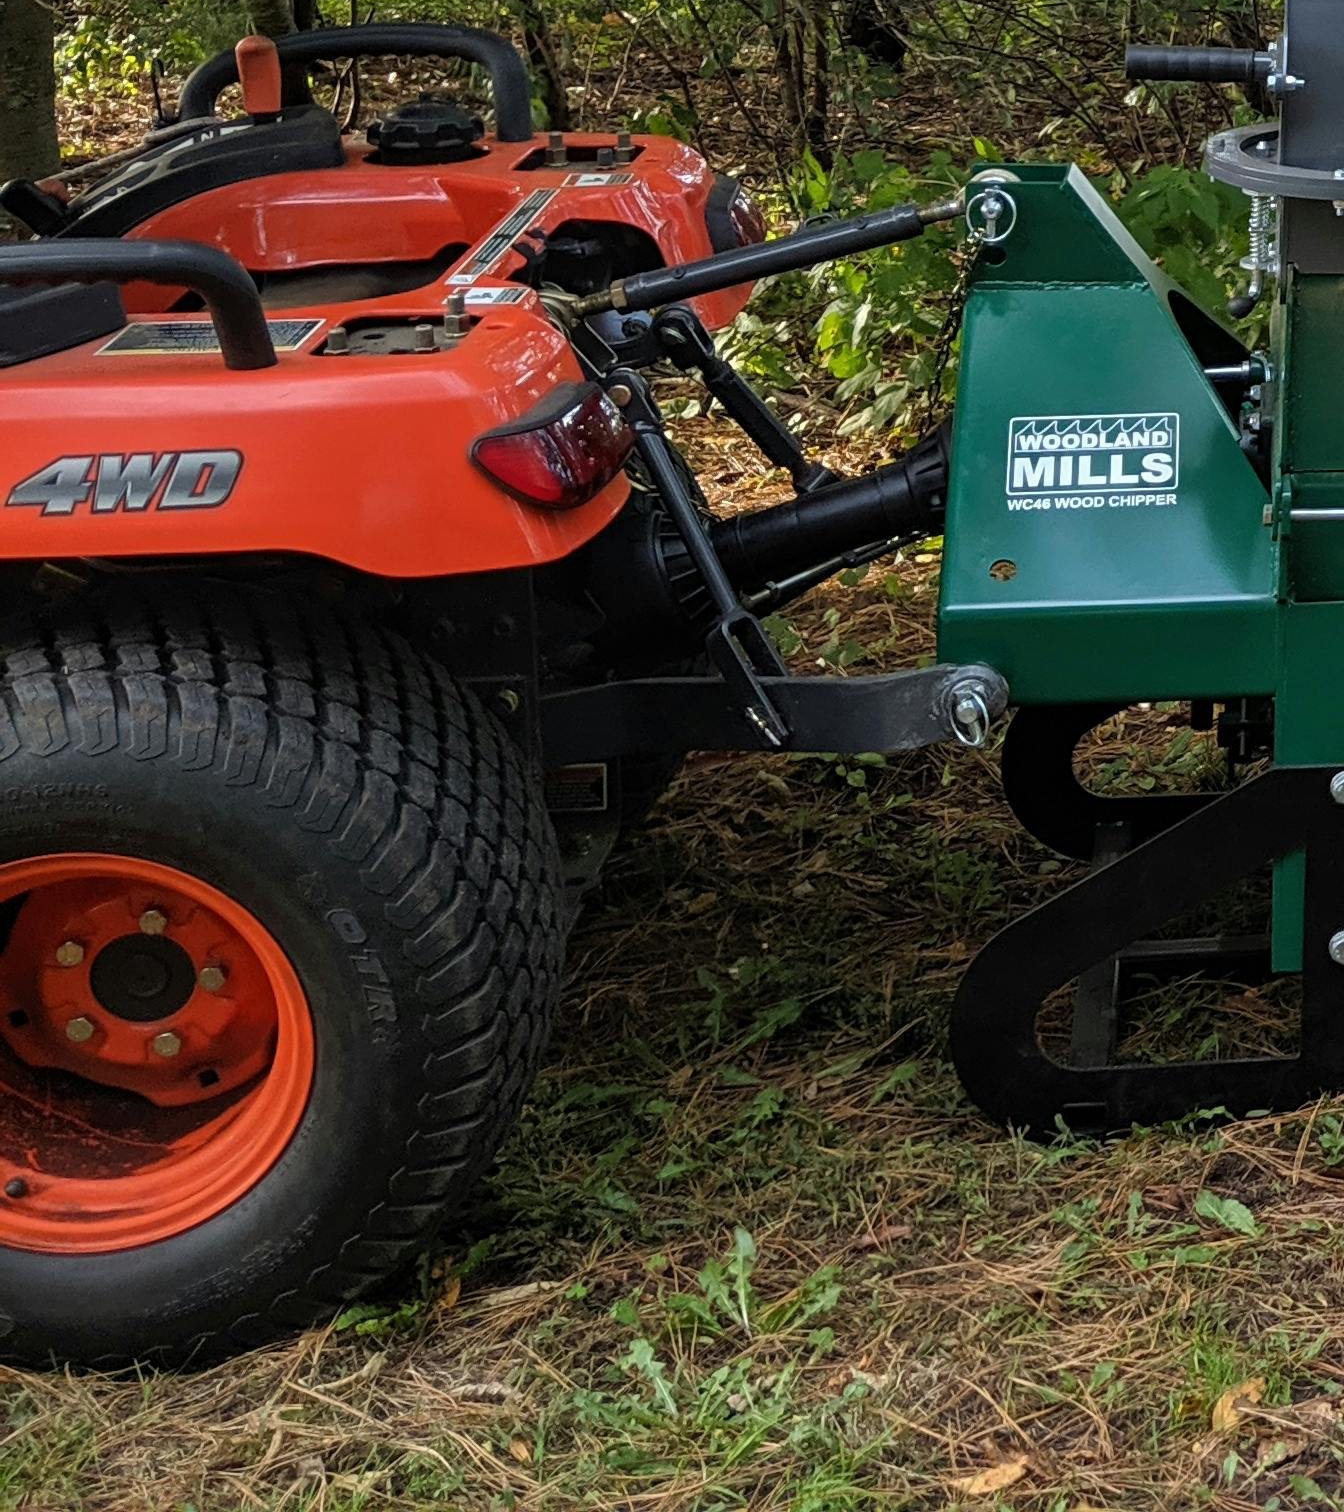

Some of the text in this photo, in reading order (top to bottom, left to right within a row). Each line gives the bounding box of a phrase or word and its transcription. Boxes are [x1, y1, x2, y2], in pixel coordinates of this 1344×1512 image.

[1019, 430, 1169, 451] WOODLAND
[5, 449, 244, 516] 4WD
[1012, 452, 1174, 488] MILLS
[1007, 493, 1178, 511] WC46 WOOD CHIPPER
[324, 908, 400, 1024] OTR
